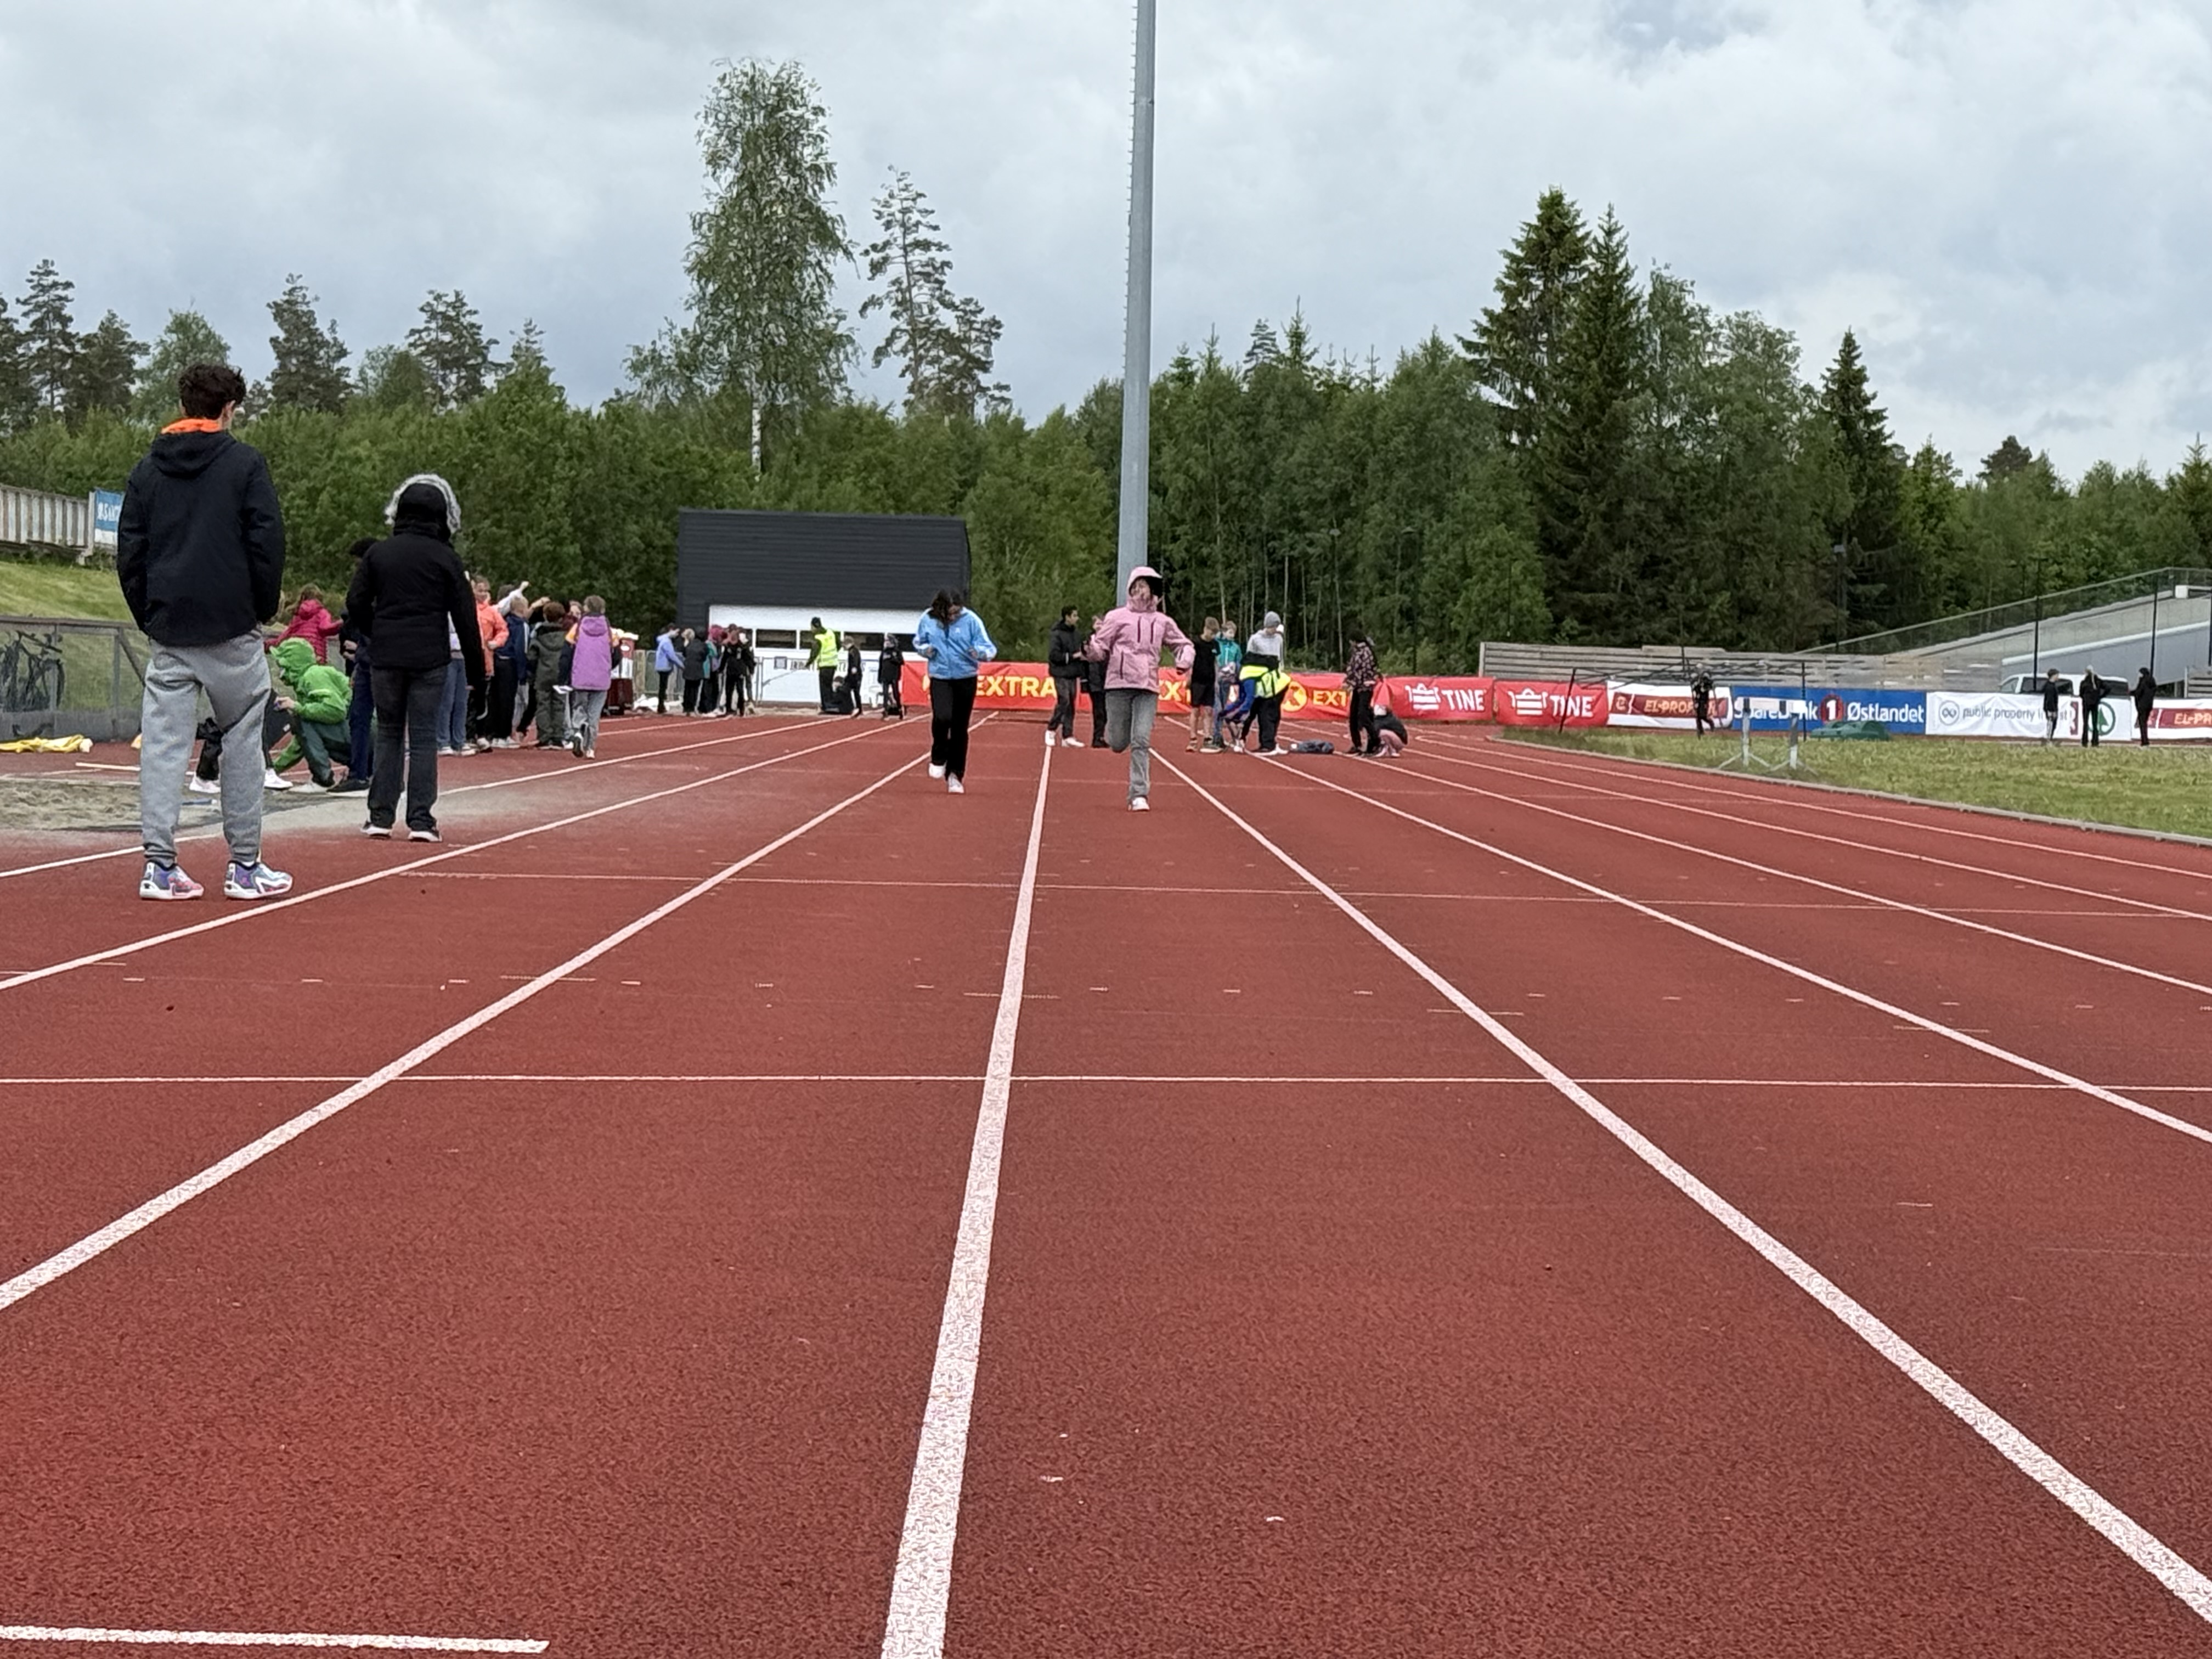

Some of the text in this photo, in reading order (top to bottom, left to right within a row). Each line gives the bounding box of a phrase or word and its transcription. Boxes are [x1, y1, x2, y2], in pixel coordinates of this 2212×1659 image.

[975, 675, 1057, 698] EXTRA
[1313, 690, 1347, 707] EXT
[1441, 689, 1485, 711] TINE
[1549, 695, 1594, 718] TINE
[1826, 699, 1837, 720] 1
[1847, 702, 1925, 723] Østlandet
[1962, 704, 1992, 720] public
[1994, 708, 2035, 723] property
